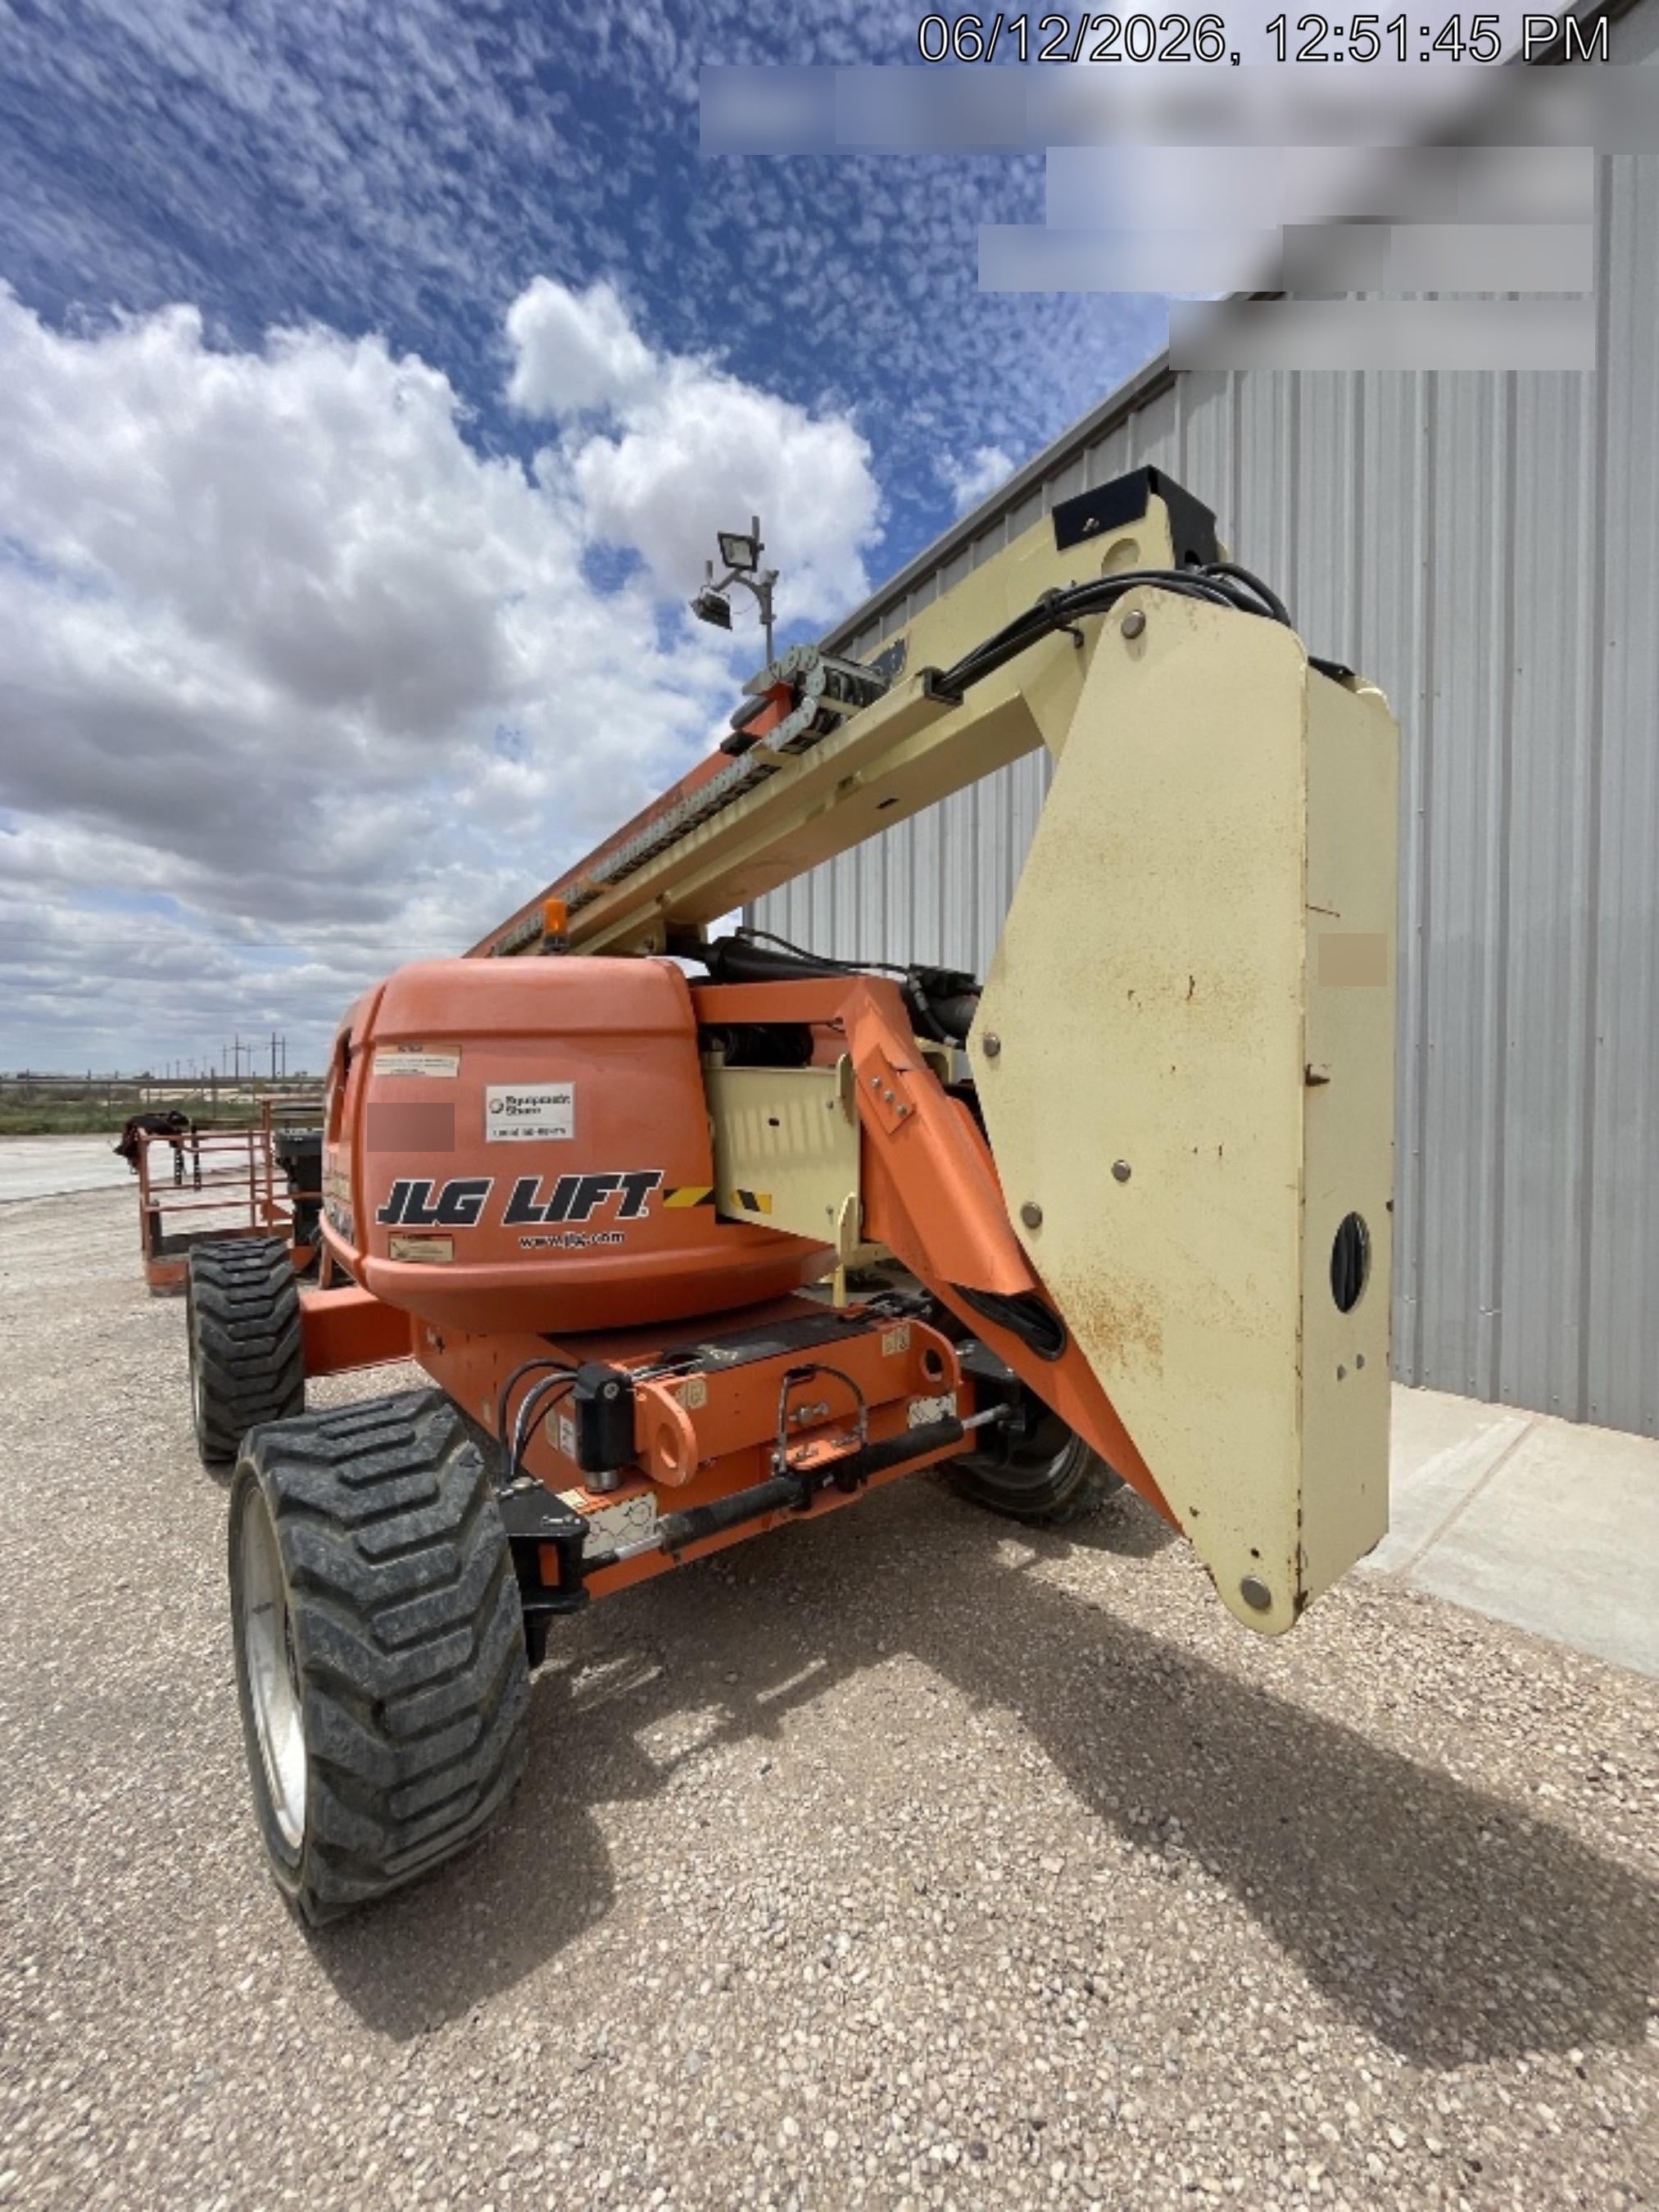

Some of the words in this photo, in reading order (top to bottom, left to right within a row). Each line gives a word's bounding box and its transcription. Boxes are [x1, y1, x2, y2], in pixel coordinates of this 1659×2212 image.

[375, 1178, 495, 1227] JLG
[501, 1170, 664, 1226] LIFT
[519, 1231, 625, 1249] www.jlg.com
